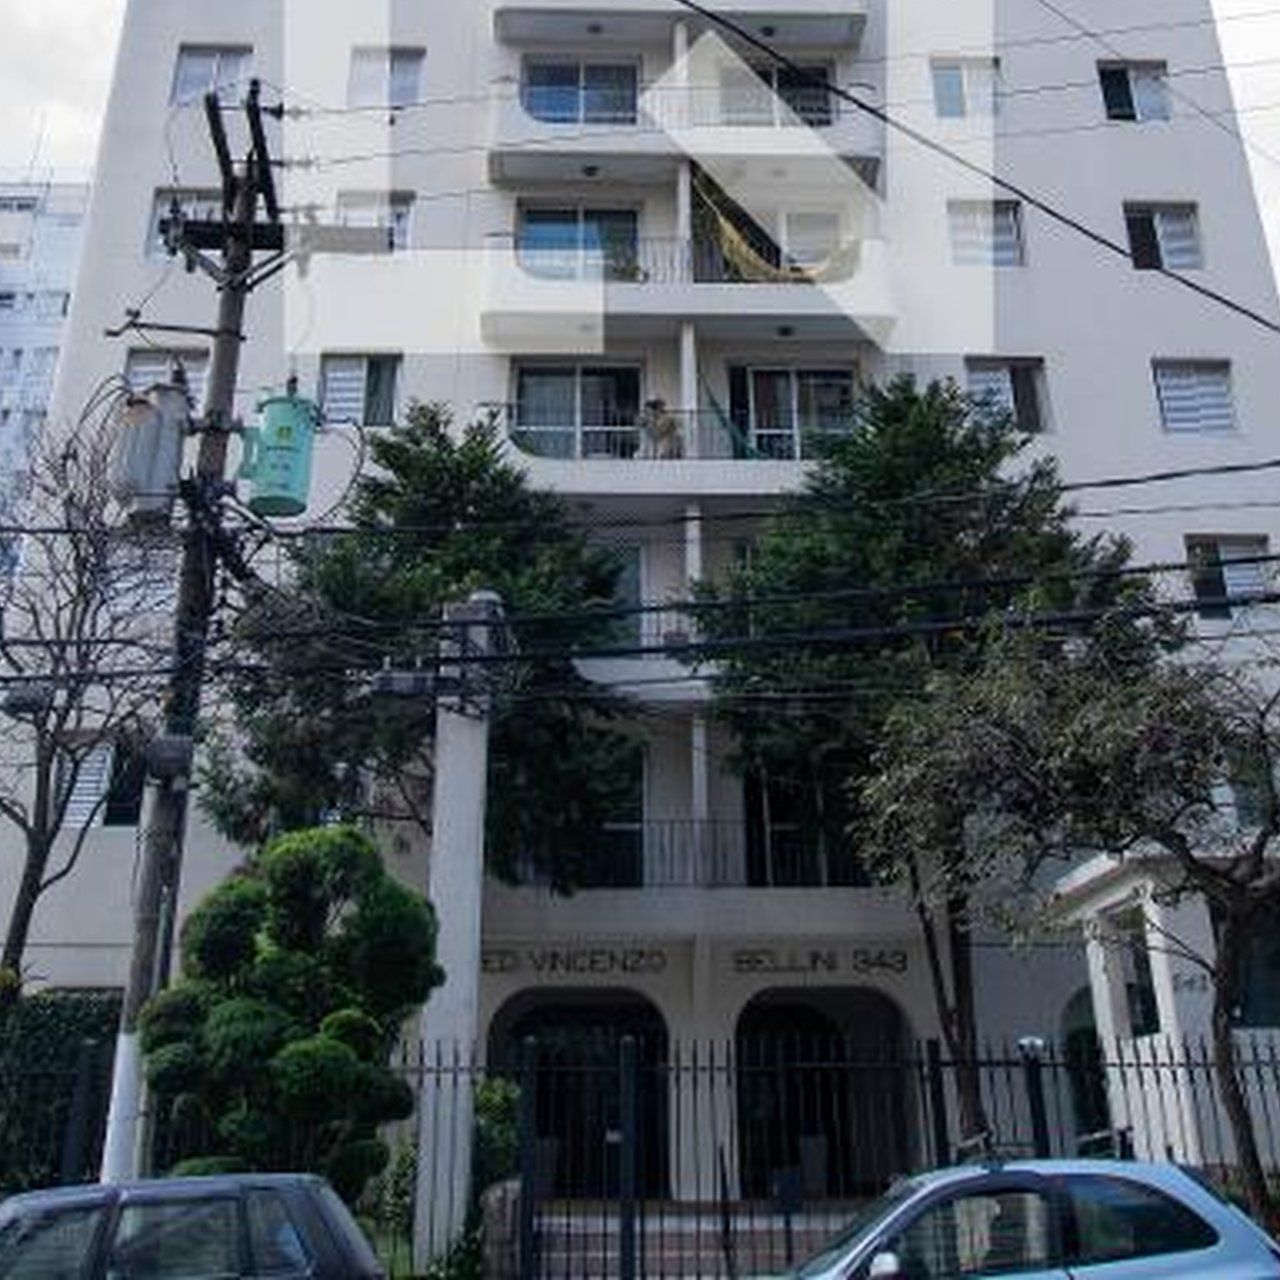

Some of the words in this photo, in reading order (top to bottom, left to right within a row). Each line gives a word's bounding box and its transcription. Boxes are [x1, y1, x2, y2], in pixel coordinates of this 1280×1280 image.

[528, 949, 667, 973] VINCENZO
[732, 949, 837, 973] BELLINI
[852, 949, 908, 973] 343
